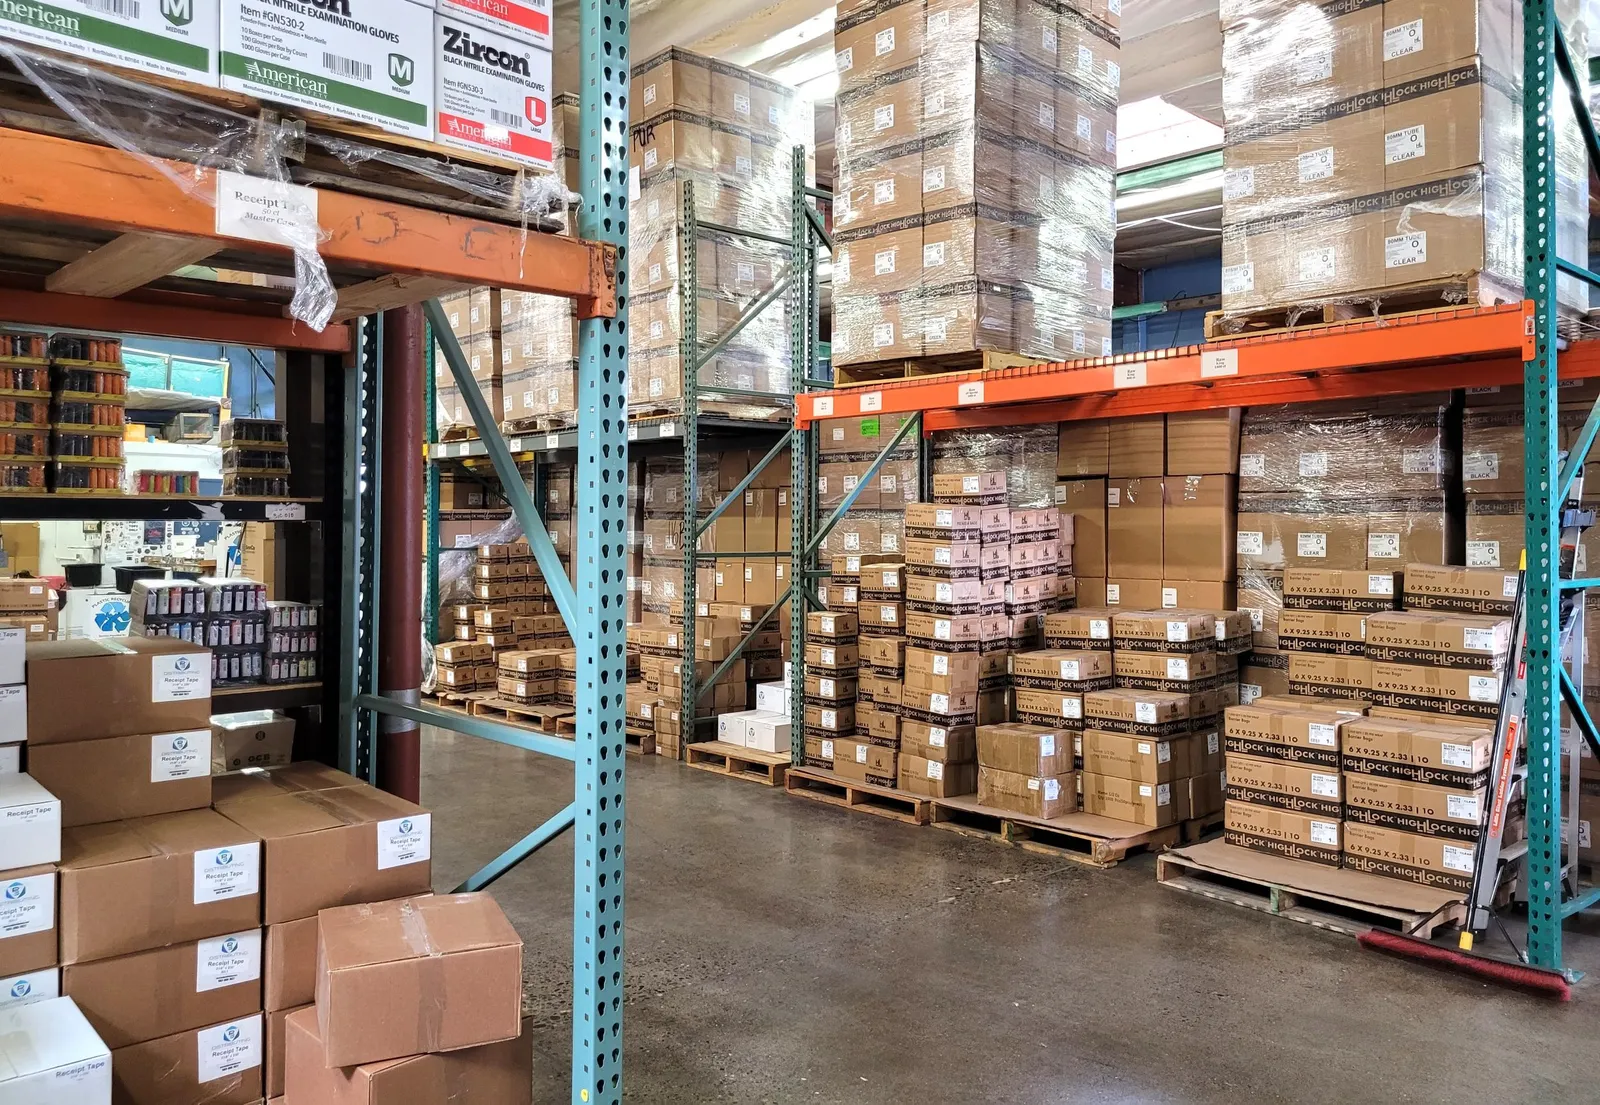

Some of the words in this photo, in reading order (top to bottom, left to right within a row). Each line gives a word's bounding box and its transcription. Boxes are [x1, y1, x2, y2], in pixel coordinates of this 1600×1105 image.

[241, 3, 260, 18] Item
[262, 10, 305, 31] #GN530-2
[165, 25, 189, 36] MEDIUM
[308, 7, 368, 33] EXAMINATION
[369, 26, 400, 44] GLOVES
[1403, 23, 1418, 32] TUBE
[248, 28, 262, 38] Boxes
[271, 35, 283, 43] Case
[241, 35, 251, 43] 100
[252, 37, 268, 47] Gloves
[268, 42, 277, 50] per
[277, 44, 285, 53] Box
[286, 46, 293, 55] by
[293, 49, 308, 59] Count
[241, 43, 254, 52] 1000
[255, 46, 270, 56] Gloves
[271, 51, 280, 59] per
[280, 54, 291, 62] Case
[443, 26, 531, 78] Zircon
[1391, 46, 1413, 57] CLEAR
[390, 56, 412, 82] M
[443, 55, 463, 67] BLACK
[463, 60, 485, 75] NITRILE
[486, 68, 525, 87] EXAMINATION
[525, 79, 546, 93] GLOVES
[245, 61, 329, 95] American
[391, 86, 411, 95] MEDIUM
[443, 77, 457, 89] Item
[457, 81, 484, 96] #GN530-3
[1330, 95, 1378, 114] HIGHLOCK
[1420, 69, 1474, 90] HIGHLOCK
[530, 99, 543, 123] L
[530, 126, 542, 134] LARGE
[1403, 128, 1419, 136] TUBE
[1392, 151, 1415, 162] CLEAR
[1304, 171, 1325, 181] CLEAR
[235, 190, 279, 209] Receipt
[245, 211, 276, 223] Master
[276, 217, 297, 227] Case
[1393, 256, 1416, 266] CLEAR
[1452, 587, 1469, 595] 2.33
[1479, 589, 1490, 597] 10
[1284, 596, 1323, 609] IGHLOCK
[1326, 598, 1374, 611] HIGHLOCK
[1453, 599, 1509, 613] HIGHLOCK
[1320, 642, 1366, 654] HIGHLOCK
[1415, 652, 1470, 666] HIGHLOCK
[1041, 679, 1072, 690] HIGHLOCK
[1420, 697, 1476, 713] HIGHLOCK
[1363, 734, 1373, 742] Bags
[161, 755, 183, 763] Receipt
[1266, 745, 1316, 760] HIGHLOCK
[1363, 748, 1380, 756] 9.25
[1390, 752, 1407, 760] 2.33
[1418, 756, 1429, 764] 10
[1392, 765, 1449, 783] HIGHLOCK
[1397, 815, 1454, 834] HIGHLOCK
[391, 837, 409, 845] Receipt
[1267, 841, 1317, 858] HIGHLOCK
[205, 871, 229, 880] Receipt
[1394, 867, 1450, 884] HIGHLOCK
[212, 1048, 235, 1057] Receipt
[56, 1066, 85, 1078] Receipt
[88, 1061, 105, 1070] Tape
